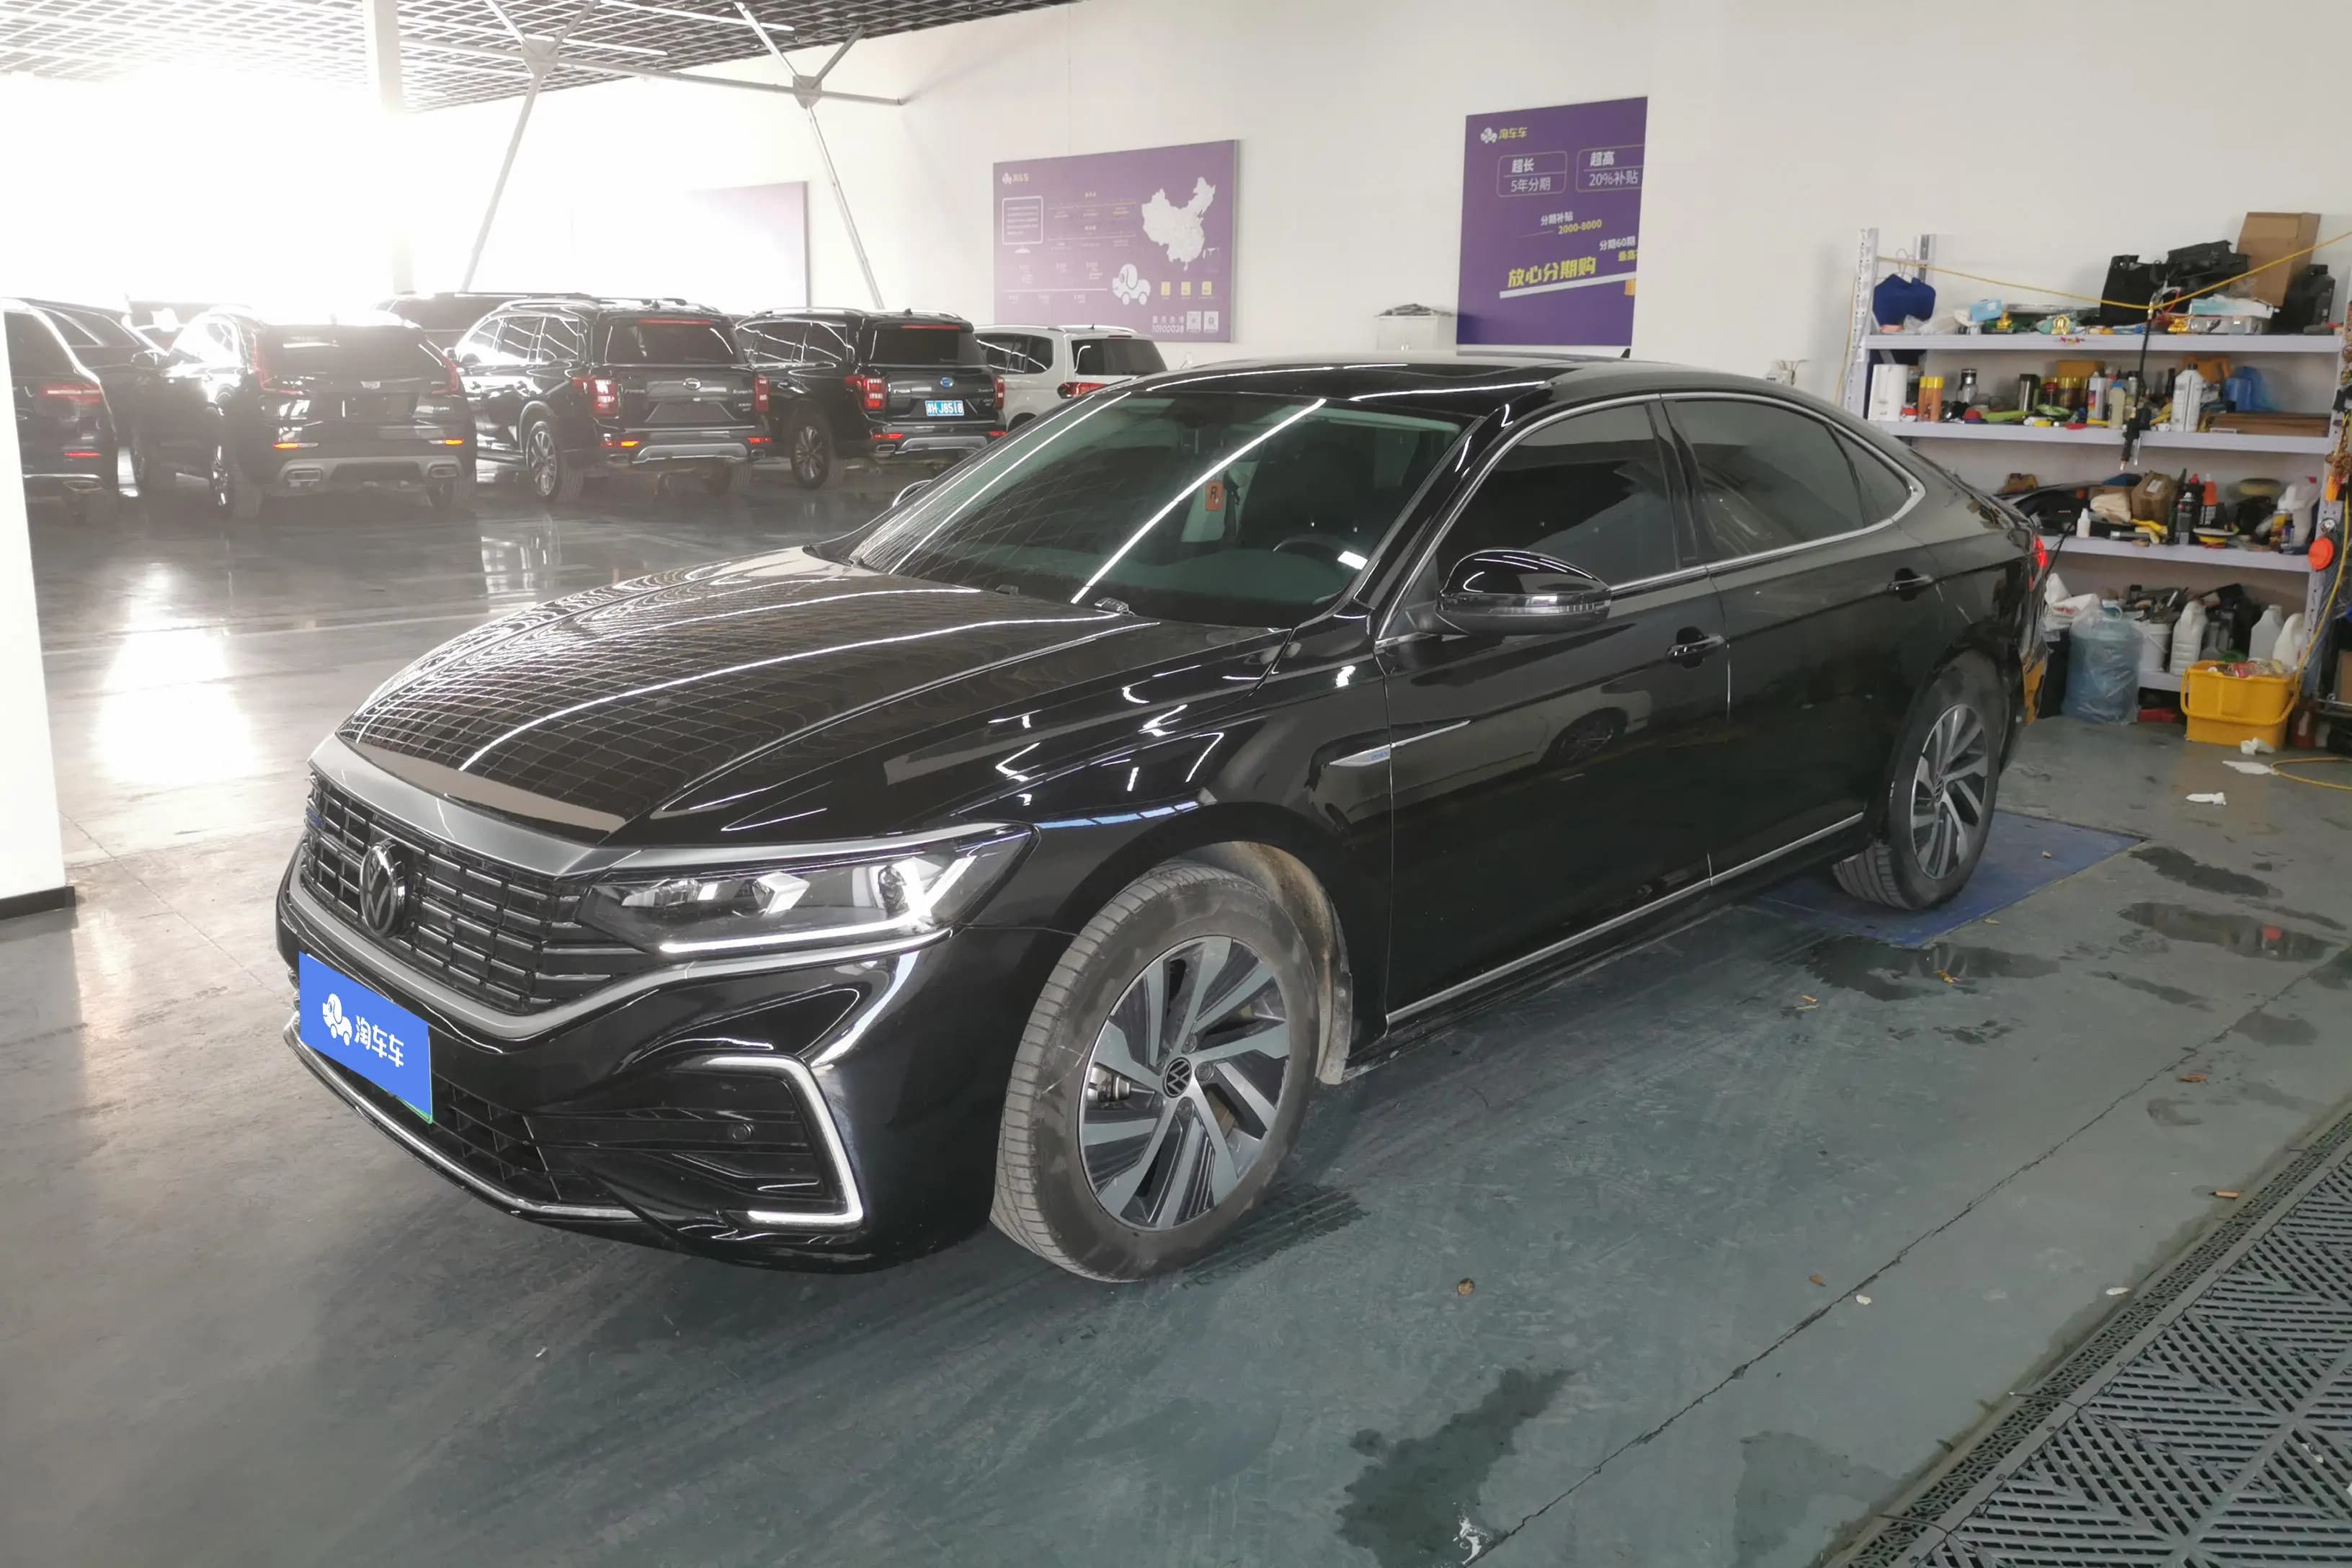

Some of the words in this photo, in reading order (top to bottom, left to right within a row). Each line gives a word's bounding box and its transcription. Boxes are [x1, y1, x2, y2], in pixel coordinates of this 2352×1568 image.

[1512, 157, 1534, 173] 超长
[1590, 151, 1615, 167] 超高
[1510, 177, 1551, 192] 5年分期
[1589, 169, 1639, 187] 20%补贴
[1508, 256, 1597, 288] 放心分期购
